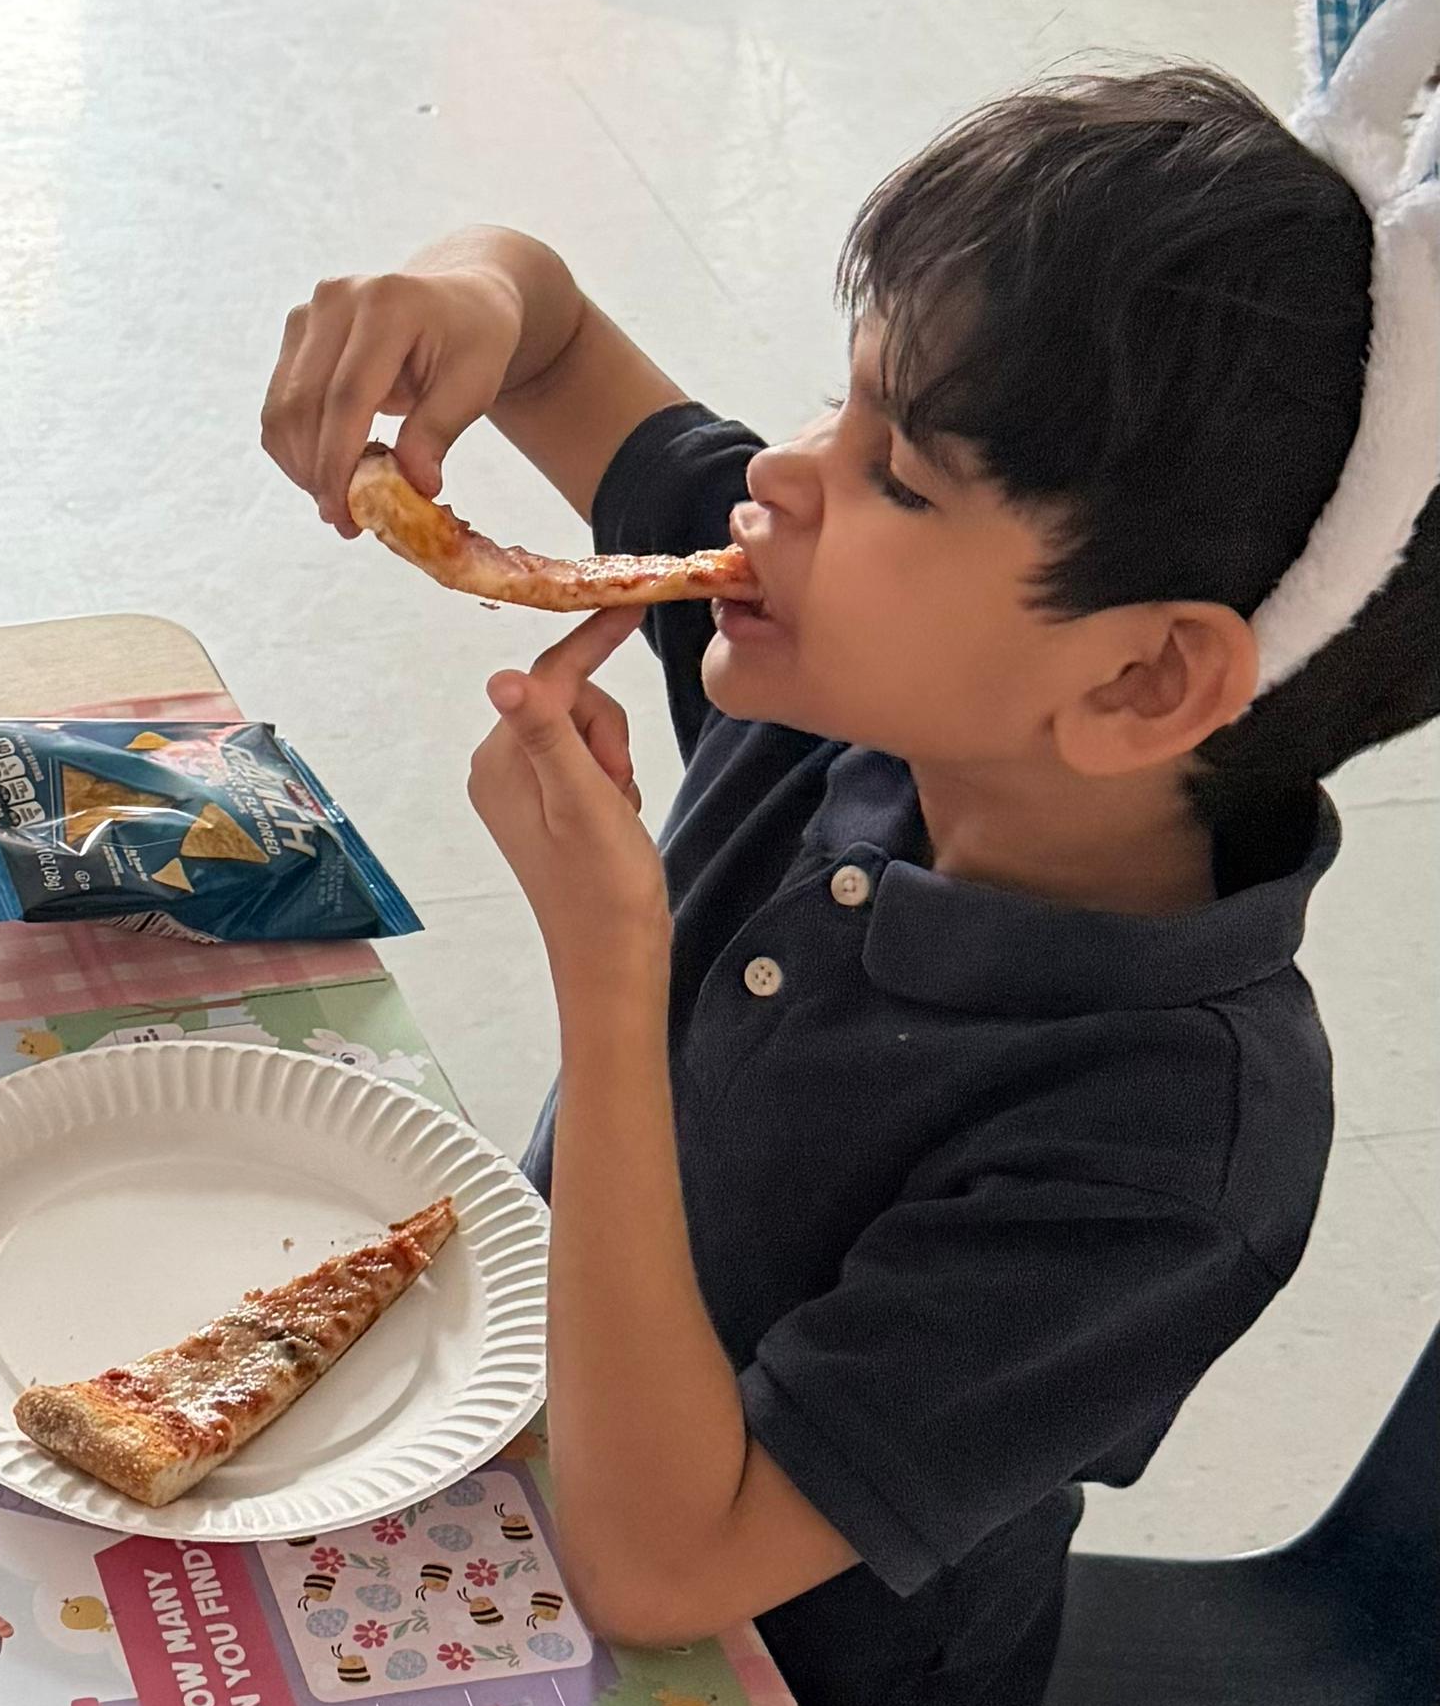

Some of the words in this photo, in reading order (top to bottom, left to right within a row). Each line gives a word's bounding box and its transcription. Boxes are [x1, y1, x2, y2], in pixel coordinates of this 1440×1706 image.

[243, 794, 282, 856] FLAVORED
[40, 866, 65, 892] (28g)
[143, 1568, 197, 1654] MANY
[205, 1622, 252, 1689] YOU
